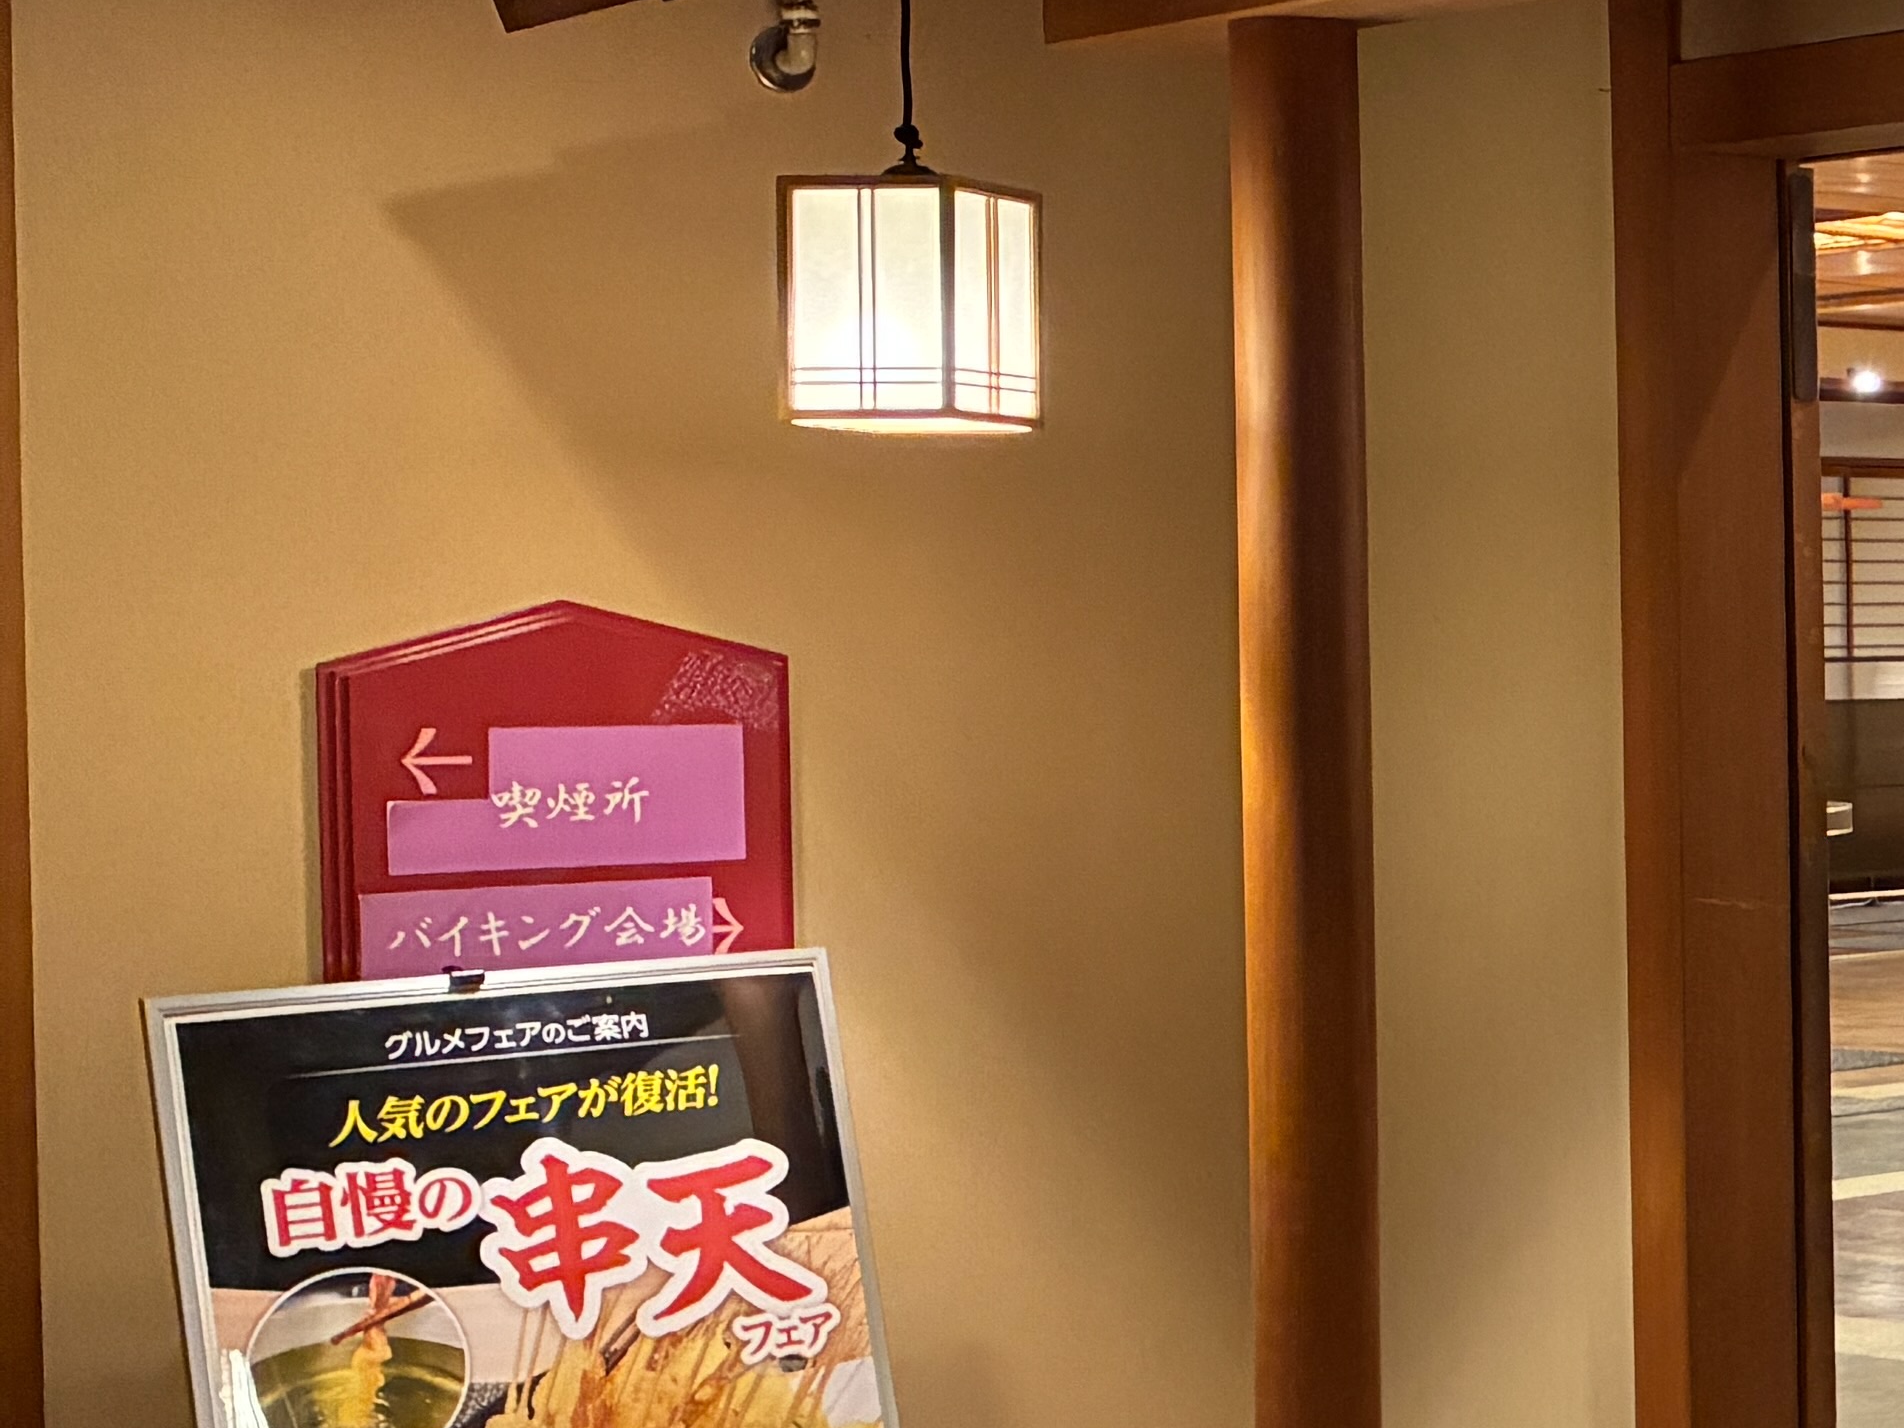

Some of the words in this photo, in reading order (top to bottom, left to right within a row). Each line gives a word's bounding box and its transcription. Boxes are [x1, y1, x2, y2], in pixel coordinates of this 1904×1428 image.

[491, 776, 650, 829] 喫煙所
[388, 903, 707, 958] バイキング会場
[384, 1011, 650, 1060] グルメフェアのご案内
[740, 1311, 835, 1358] フェア
